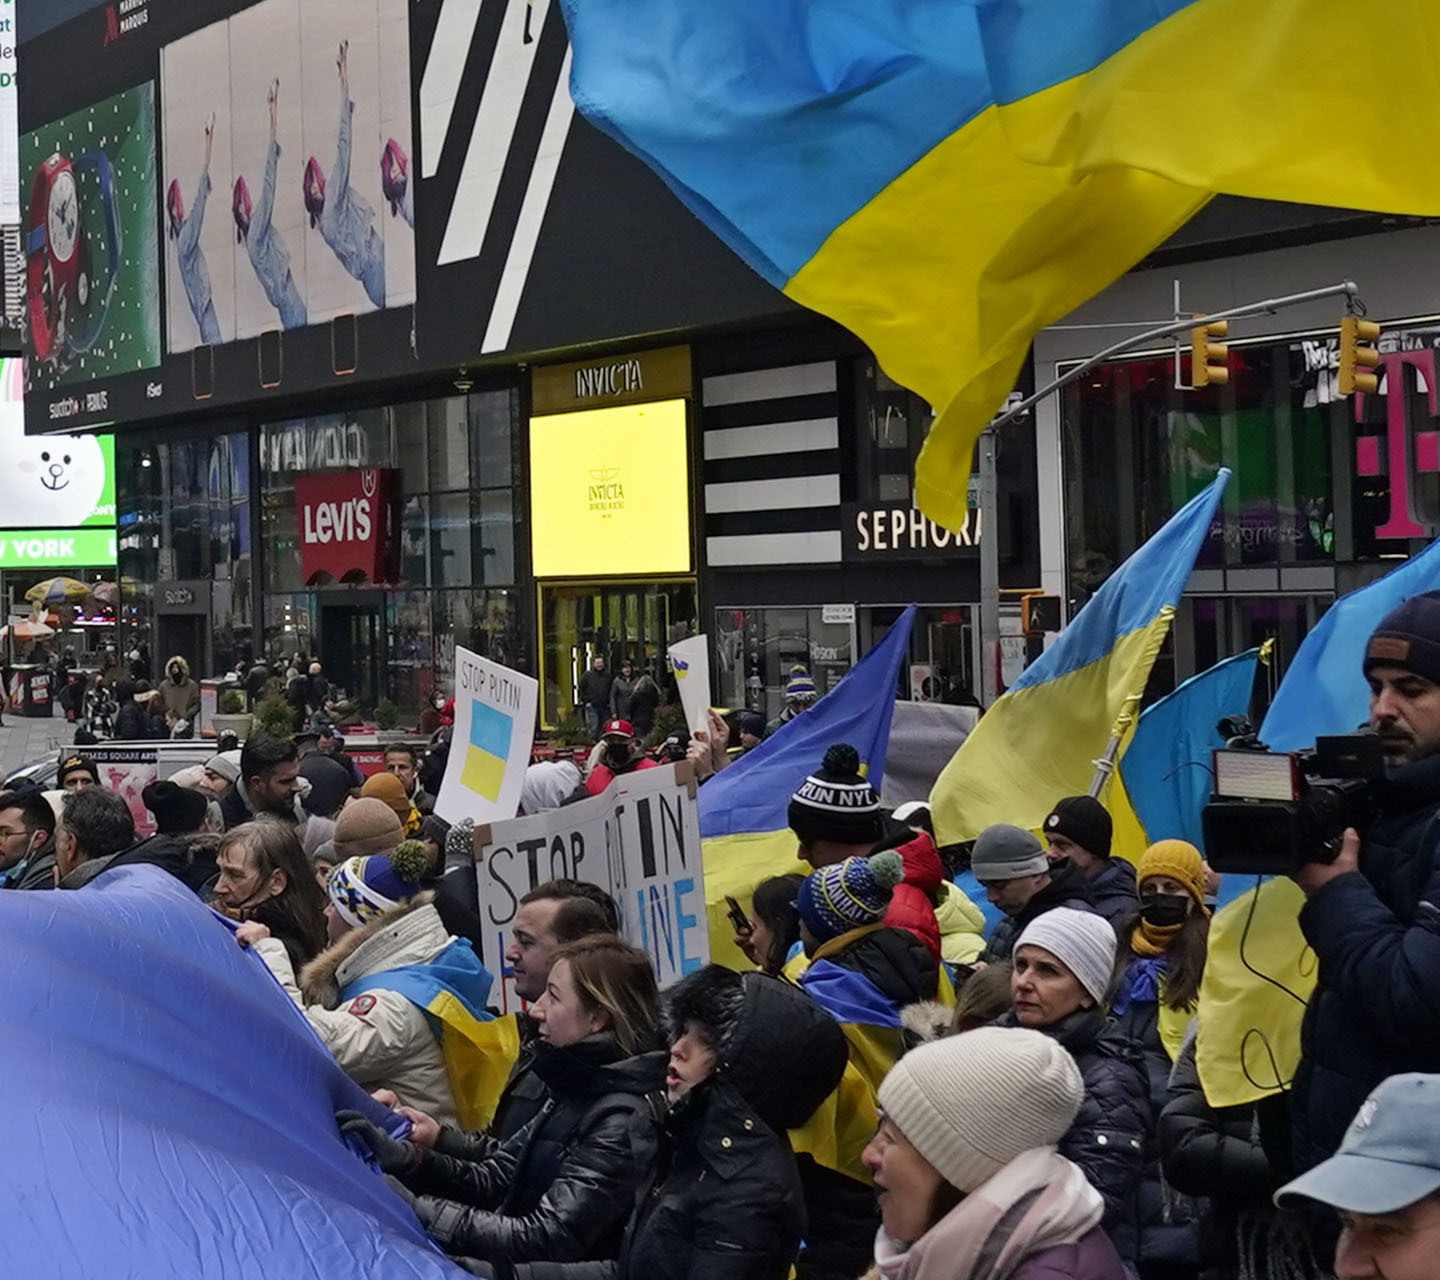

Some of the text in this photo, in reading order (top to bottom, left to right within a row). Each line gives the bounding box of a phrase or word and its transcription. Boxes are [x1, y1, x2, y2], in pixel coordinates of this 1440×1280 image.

[120, 9, 148, 33] MARQUIS
[575, 361, 644, 398] INVICTA
[1355, 347, 1439, 539] T
[588, 481, 625, 502] INVICTA
[13, 539, 74, 557] YORK
[461, 661, 521, 712] STOP PUTIN
[800, 781, 834, 803] RUN
